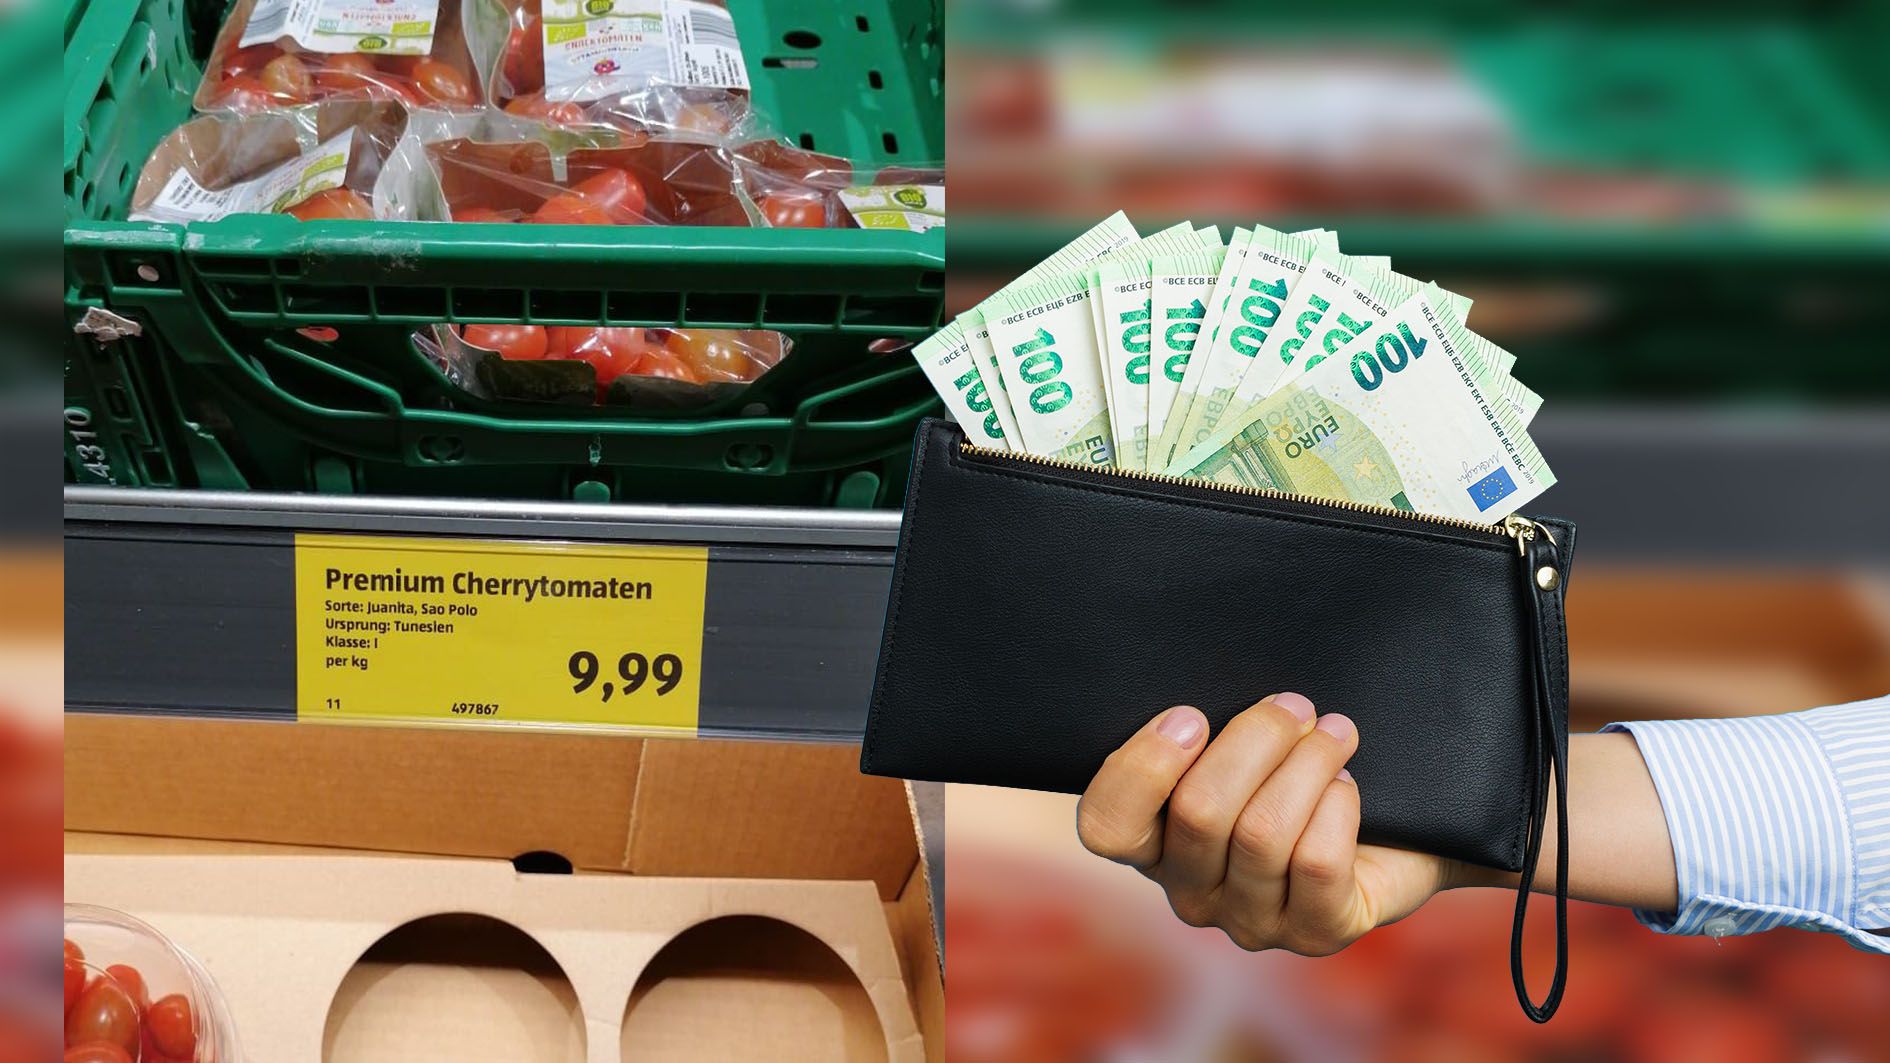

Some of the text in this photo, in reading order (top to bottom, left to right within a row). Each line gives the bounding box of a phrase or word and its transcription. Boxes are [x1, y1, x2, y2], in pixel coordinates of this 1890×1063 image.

[1280, 259, 1297, 270] ECB
[1026, 306, 1044, 318] ECB
[1066, 293, 1083, 304] EZB
[1230, 277, 1289, 358] 100
[1371, 303, 1388, 318] ECB
[1163, 298, 1207, 383] 100
[1349, 320, 1428, 392] 100
[1012, 327, 1073, 415] 100
[1431, 323, 1445, 340] ECB
[1451, 356, 1465, 373] EZB
[1461, 372, 1474, 389] EKP
[1481, 404, 1494, 421] ESB
[1491, 420, 1505, 438] EKB
[1511, 453, 1525, 471] EBC
[1523, 470, 1535, 485] 2019
[1085, 434, 1111, 469] EU
[1284, 415, 1340, 459] EURO
[326, 568, 653, 602] Premium Cherrytomaten
[325, 600, 478, 616] Sorte: Juanita, Sao Polo
[325, 618, 454, 633] Ursprung: Tunesien
[326, 636, 371, 648] Klasse:
[326, 655, 368, 670] per kg
[568, 651, 683, 703] 9,99
[326, 699, 341, 709] 11
[451, 703, 499, 715] 497867
